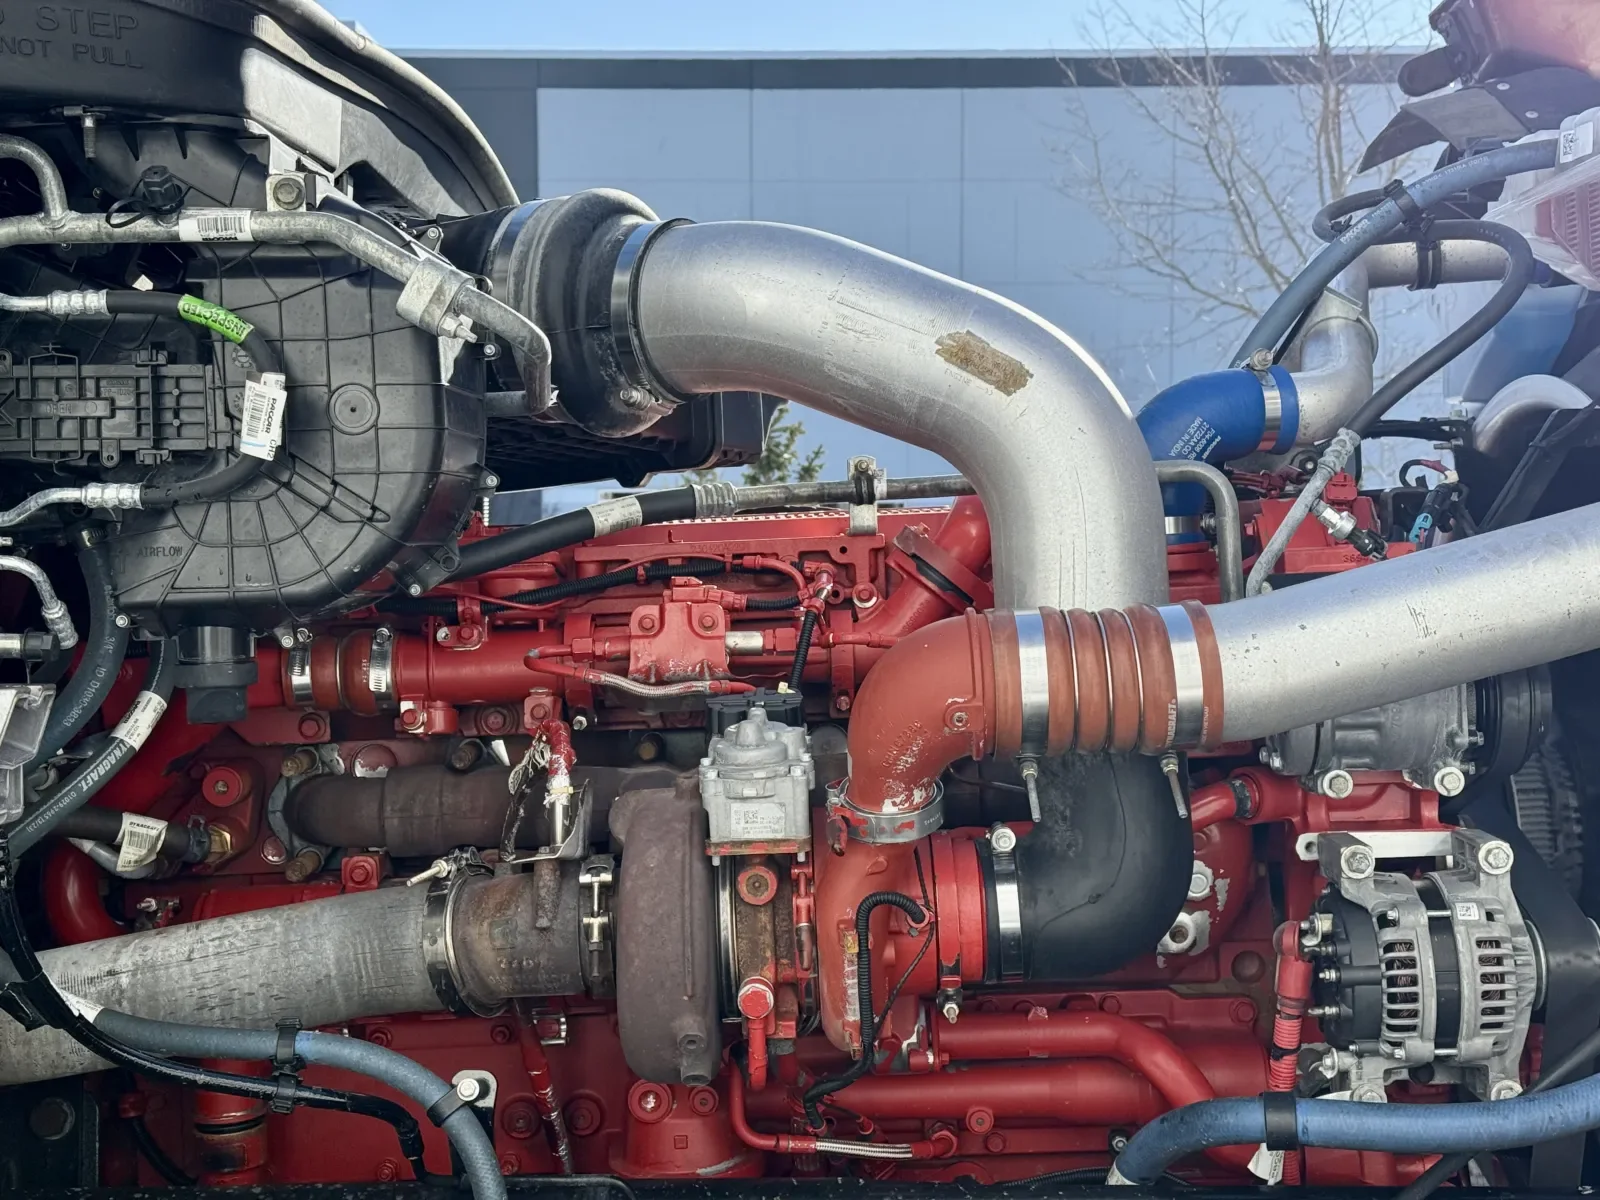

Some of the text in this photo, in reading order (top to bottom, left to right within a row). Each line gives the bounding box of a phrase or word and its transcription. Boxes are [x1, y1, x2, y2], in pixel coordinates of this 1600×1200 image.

[36, 6, 139, 39] STEP
[0, 36, 144, 69] NOT PULL
[183, 302, 246, 337] INSPECTED
[45, 403, 72, 414] OPEN
[264, 397, 277, 434] PACCAR
[267, 439, 277, 459] CH2
[1168, 416, 1203, 457] MADE IN INDIA
[137, 546, 183, 557] AIRFLOW
[95, 666, 107, 678] ID
